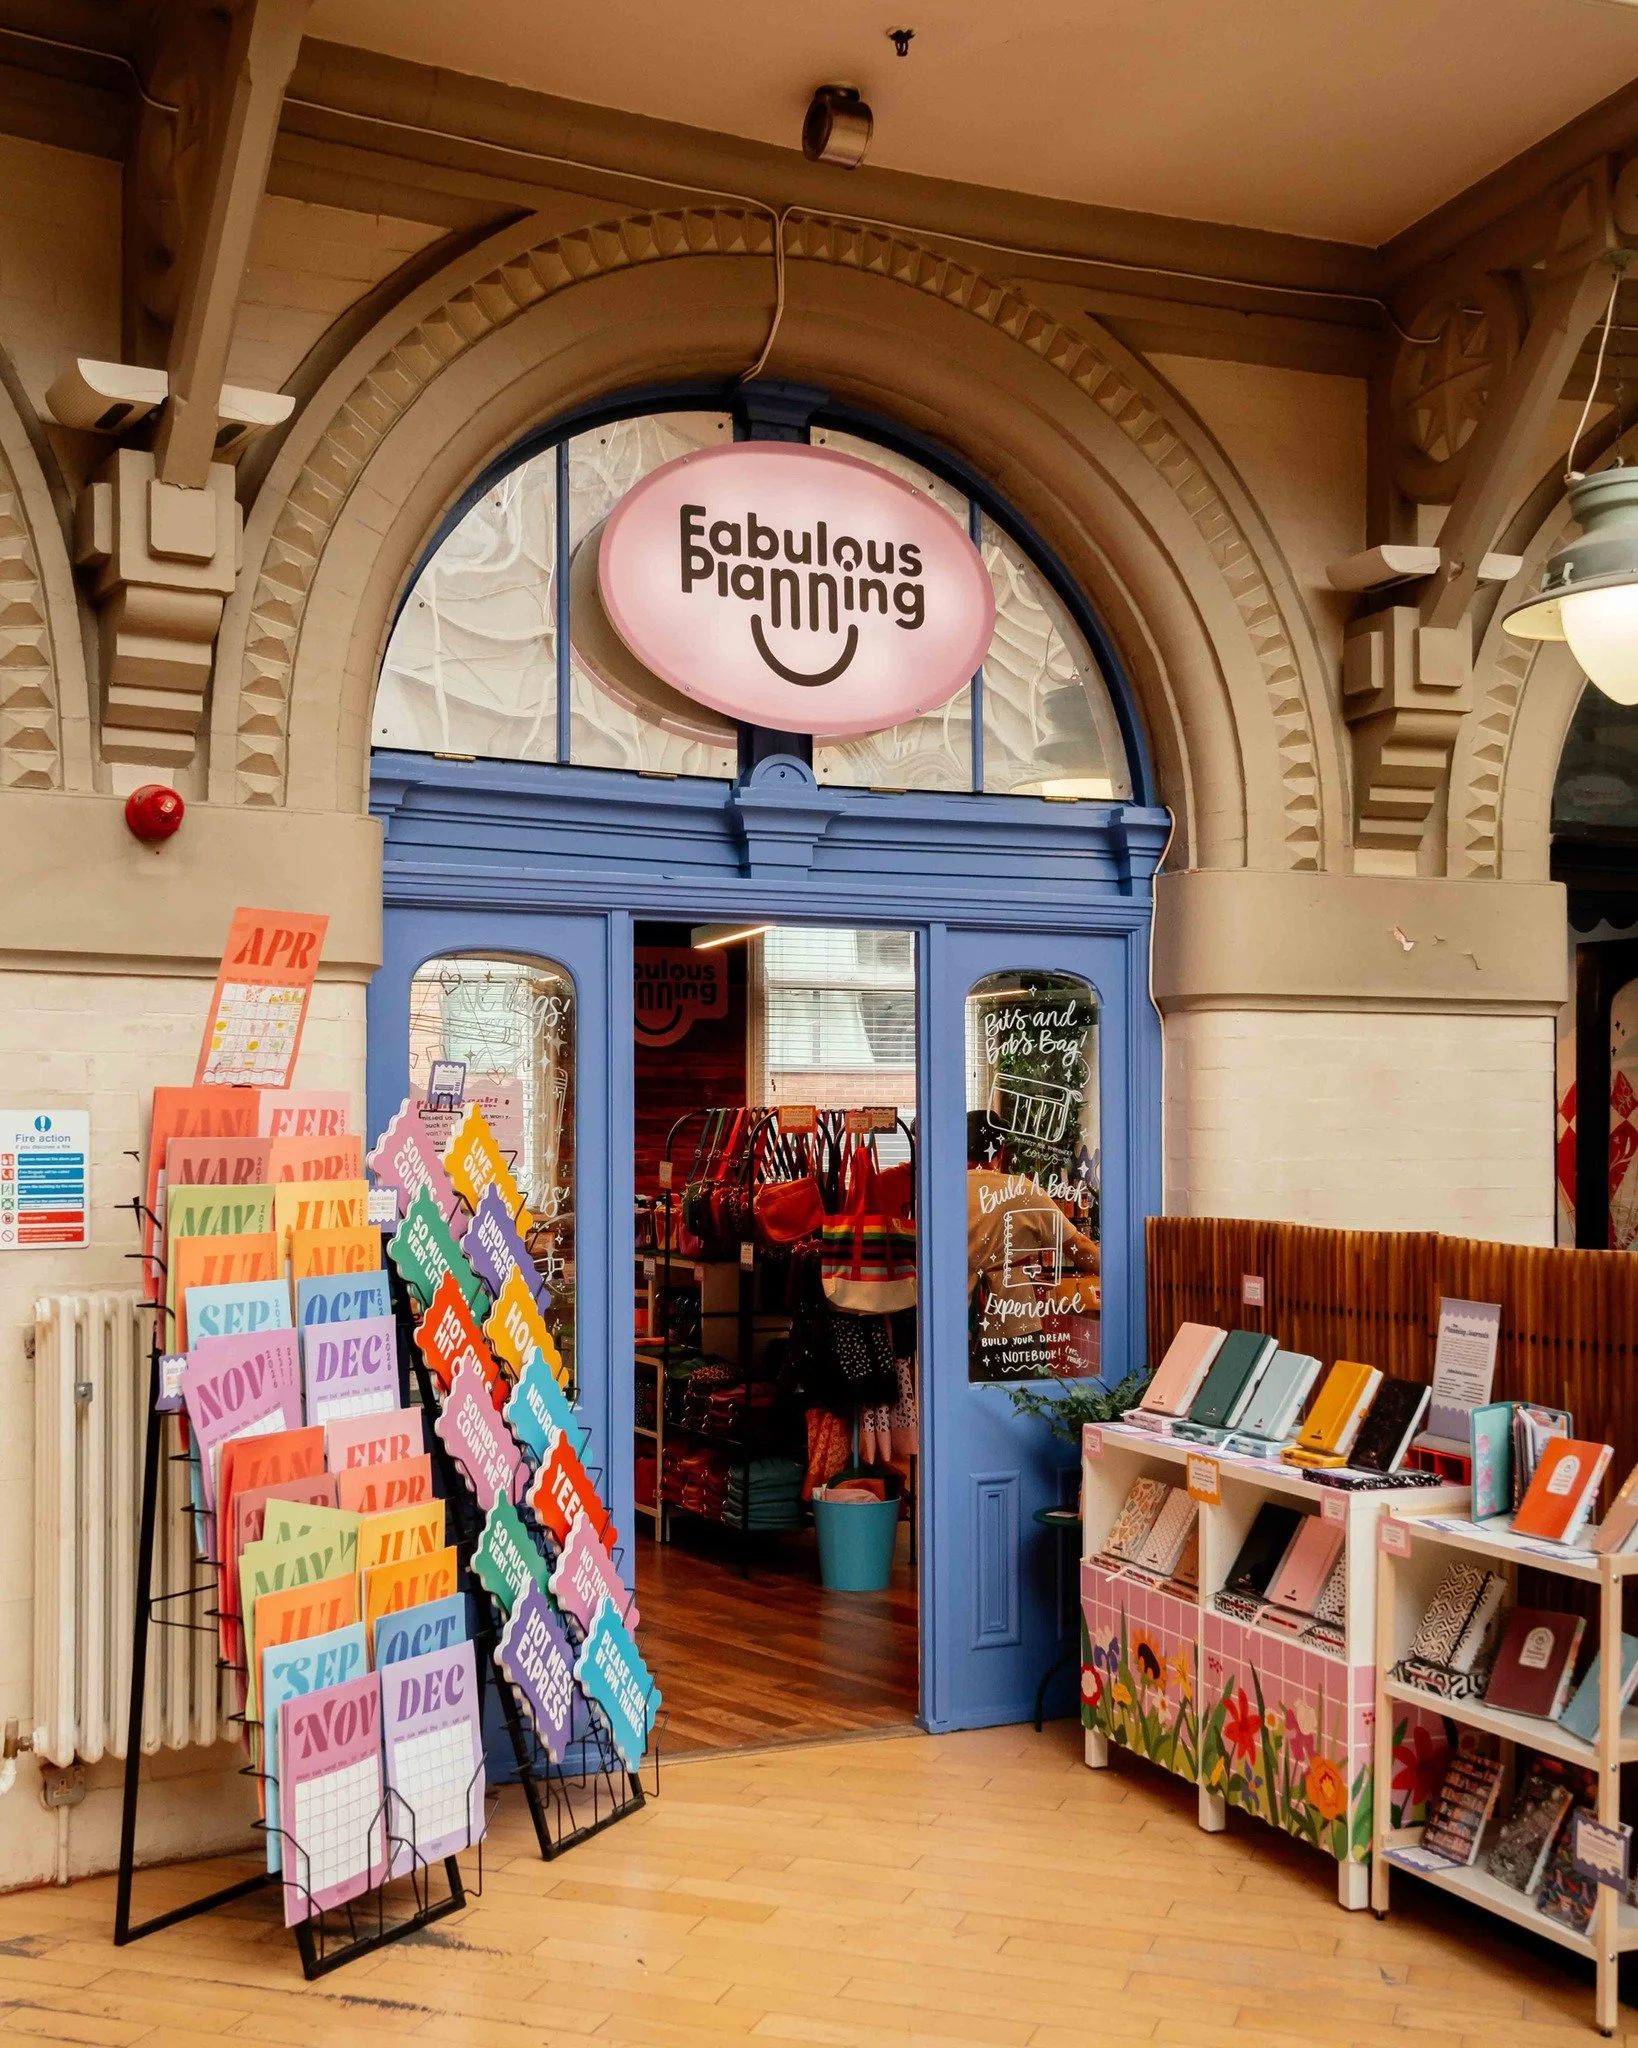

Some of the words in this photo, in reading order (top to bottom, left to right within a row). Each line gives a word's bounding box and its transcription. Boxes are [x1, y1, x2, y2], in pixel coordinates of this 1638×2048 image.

[680, 504, 923, 577] Fabulous
[681, 545, 925, 634] Planning
[233, 928, 317, 969] APR
[984, 1008, 1029, 1037] Bits
[1033, 1000, 1078, 1027] and
[1036, 1029, 1088, 1066] Bag!
[15, 1133, 36, 1143] Fire
[39, 1133, 71, 1143] action
[179, 1157, 256, 1184] MAR
[394, 1151, 418, 1200] COUN
[979, 1174, 1027, 1214] Build
[1048, 1174, 1090, 1210] Book
[180, 1204, 256, 1237] MAY
[285, 1199, 356, 1239] JUN
[413, 1214, 429, 1241] SO
[478, 1224, 494, 1253] BUT
[306, 1244, 366, 1277] AUG
[407, 1229, 428, 1266] VERY
[199, 1300, 270, 1337] SEP
[305, 1289, 376, 1325] OCT
[442, 1304, 467, 1350] HOT
[984, 1292, 1086, 1324] Experience
[315, 1334, 383, 1383] DEC
[433, 1323, 455, 1361] HIT
[981, 1336, 1008, 1348] BUILD
[1012, 1334, 1035, 1345] YOUR
[1039, 1332, 1071, 1343] DREAM
[1002, 1347, 1061, 1364] NOTEBOOK!
[196, 1353, 266, 1428] NOV
[456, 1410, 487, 1465] COUNT
[463, 1393, 498, 1459] SOUNDS
[357, 1475, 426, 1513] APR
[371, 1521, 438, 1566] JUN
[493, 1520, 508, 1547] SO
[254, 1546, 334, 1596] MAY
[488, 1536, 508, 1574] VERY
[580, 1545, 593, 1572] NO
[384, 1568, 450, 1615] AUG
[572, 1564, 597, 1608] JUST
[386, 1615, 456, 1664] OCT
[526, 1607, 552, 1656] HOT
[546, 1644, 575, 1706] MESS
[601, 1629, 630, 1686] PLEASE
[272, 1642, 360, 1700] SEP
[515, 1632, 567, 1731] EXPRESS
[397, 1664, 465, 1722] DEC
[618, 1688, 643, 1738] THANKS
[294, 1690, 377, 1759] NOV
